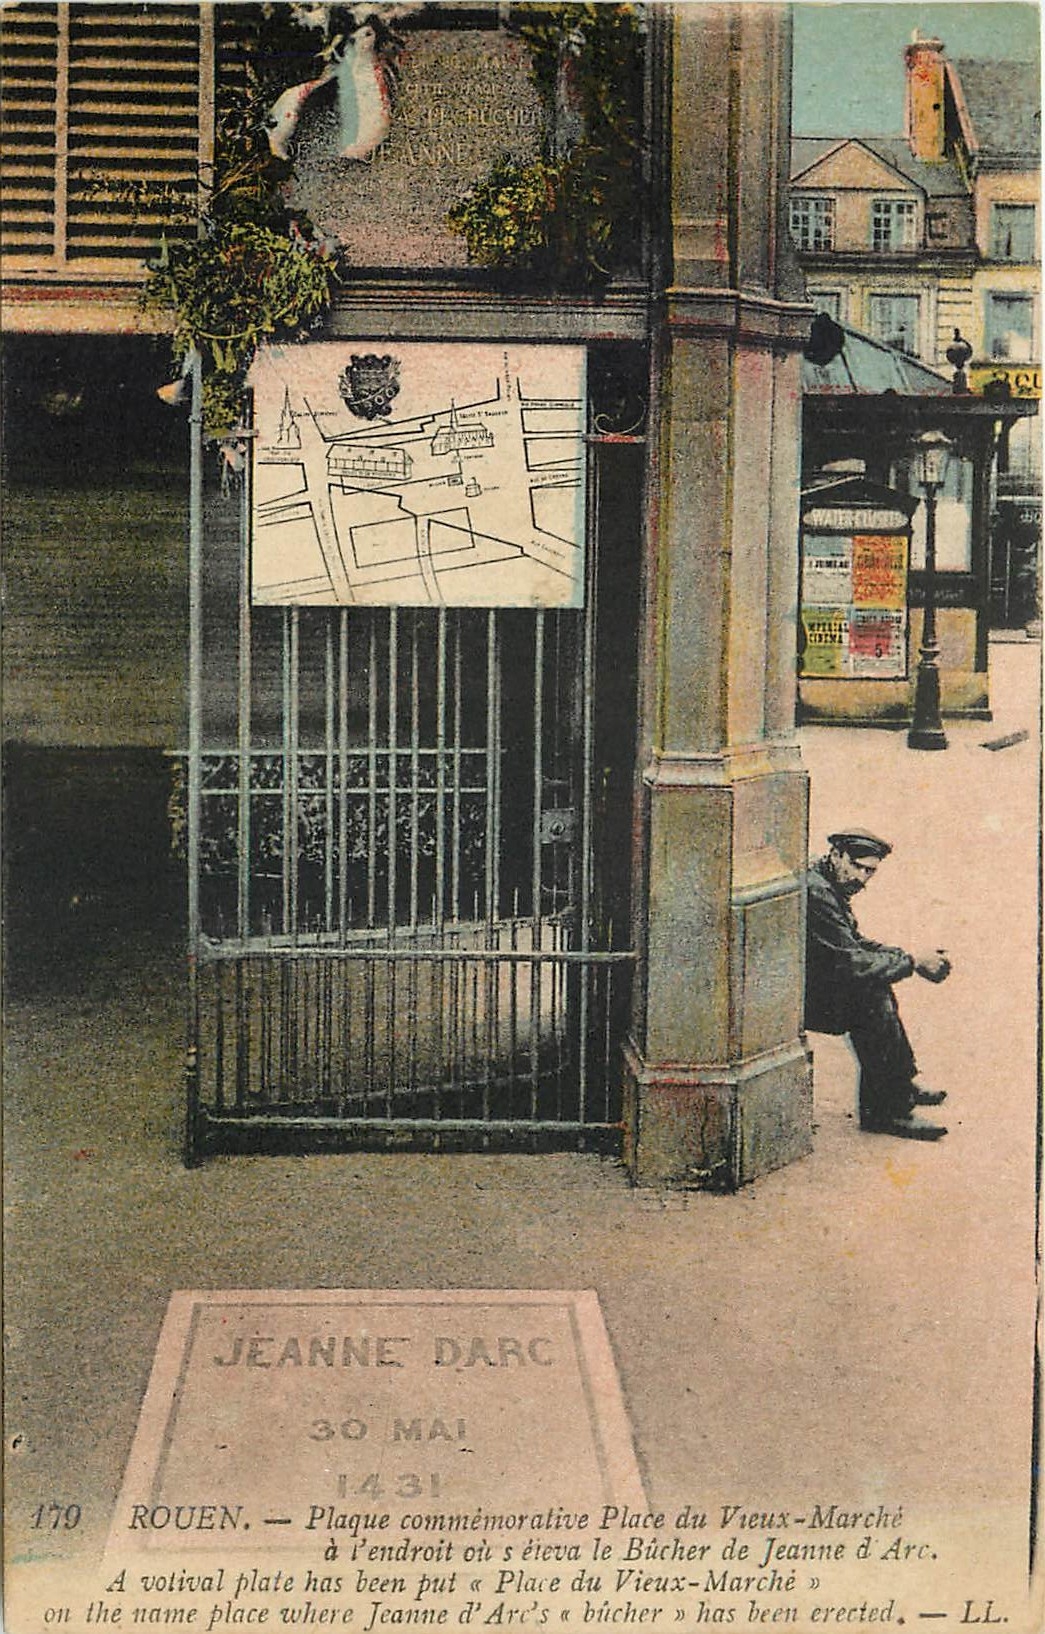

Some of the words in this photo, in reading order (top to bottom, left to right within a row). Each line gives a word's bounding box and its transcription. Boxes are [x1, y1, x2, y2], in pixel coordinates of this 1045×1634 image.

[213, 1336, 411, 1368] JEANNE
[308, 1418, 369, 1442] 30
[393, 1418, 469, 1442] MAI
[336, 1474, 442, 1499] 1431
